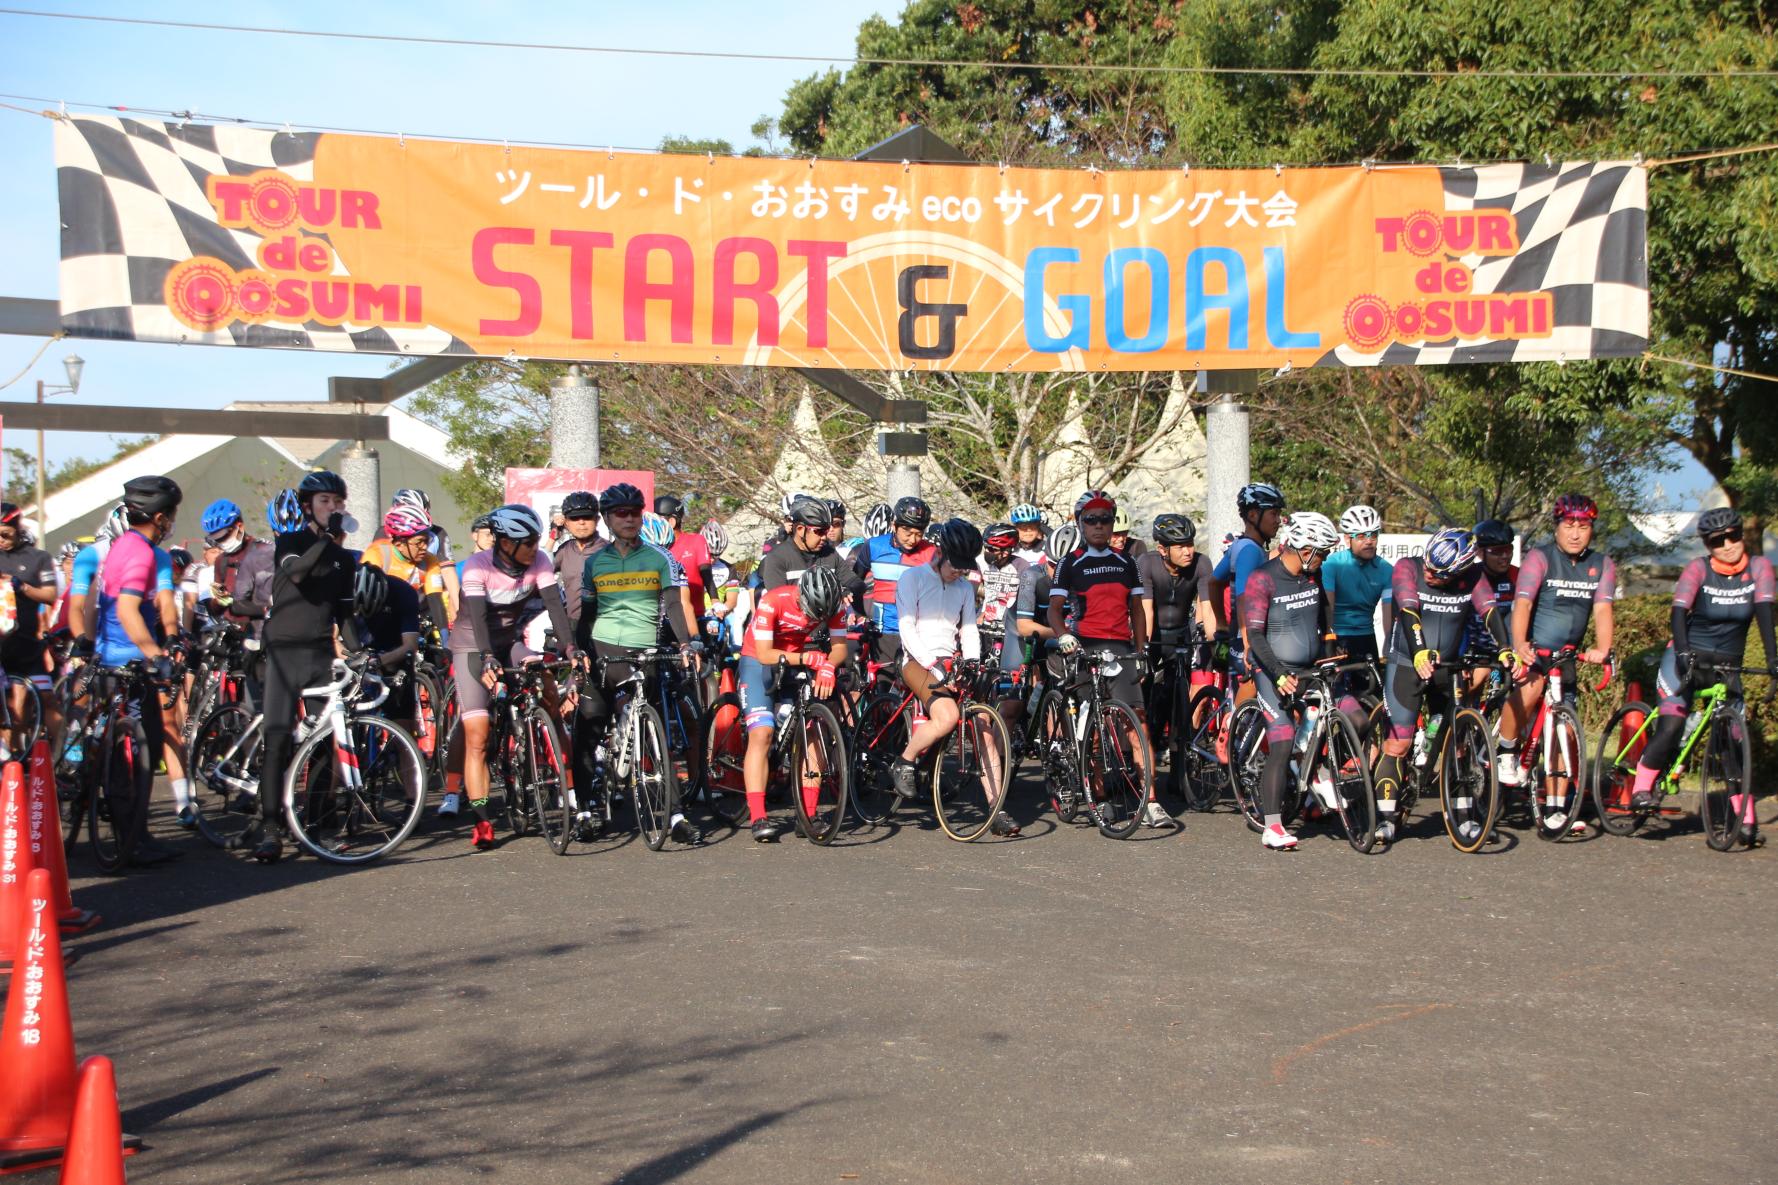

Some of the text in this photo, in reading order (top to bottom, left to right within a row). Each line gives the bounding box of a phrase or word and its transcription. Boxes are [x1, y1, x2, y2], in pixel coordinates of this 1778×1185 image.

[214, 176, 382, 232] TOUR
[922, 197, 982, 223] eco
[994, 189, 1299, 230] サイクリング大会
[1374, 209, 1516, 258] TOUR
[263, 235, 328, 273] de
[471, 226, 1321, 360] START & GOAL
[1415, 262, 1470, 294] de
[1083, 566, 1125, 576] SHIMANO
[1286, 598, 1318, 611] PEDAL
[1423, 603, 1462, 614] PEDAL
[1556, 589, 1592, 599] PEDAL
[1711, 596, 1748, 605] PEDAL
[21, 898, 47, 1044] ツール・ド・おおすみ 18
